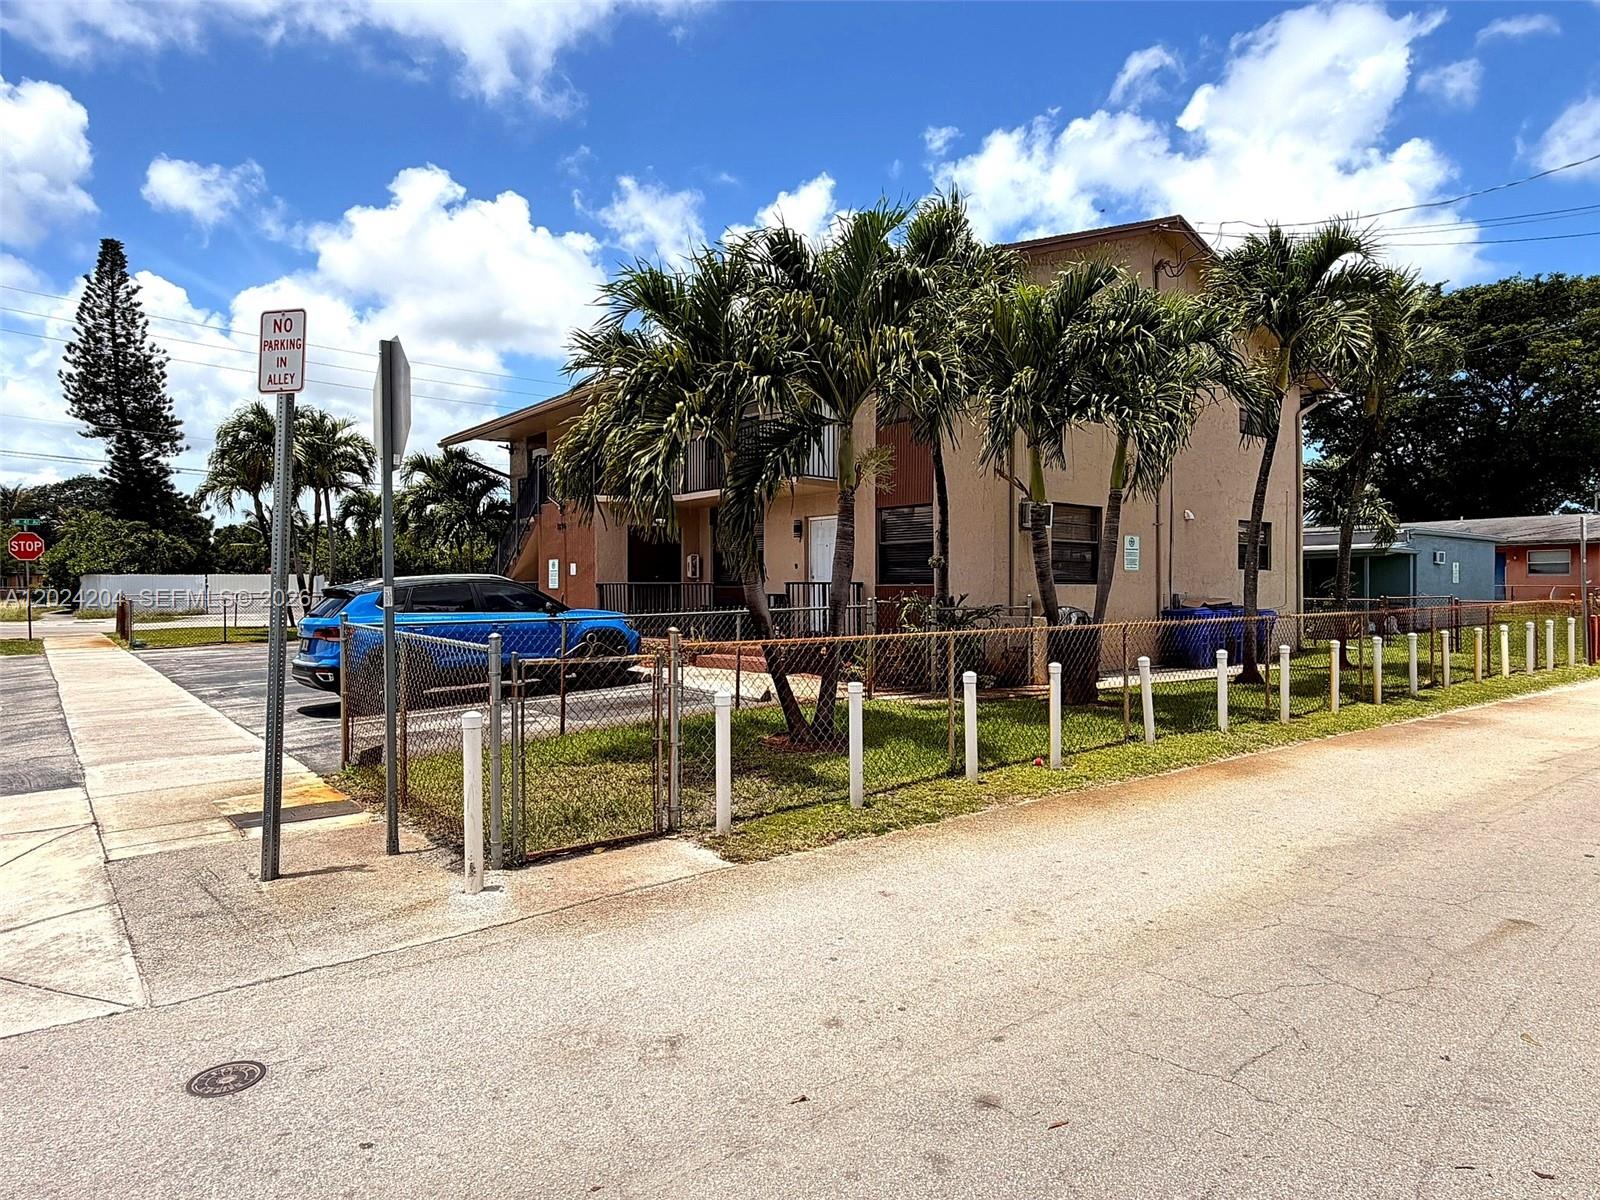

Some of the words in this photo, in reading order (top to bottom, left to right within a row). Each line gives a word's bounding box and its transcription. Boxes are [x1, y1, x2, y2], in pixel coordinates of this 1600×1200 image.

[273, 318, 293, 333] NO
[263, 338, 302, 351] PARKING
[276, 356, 287, 368] IN
[267, 373, 295, 386] ALLEY
[10, 541, 42, 552] STOP
